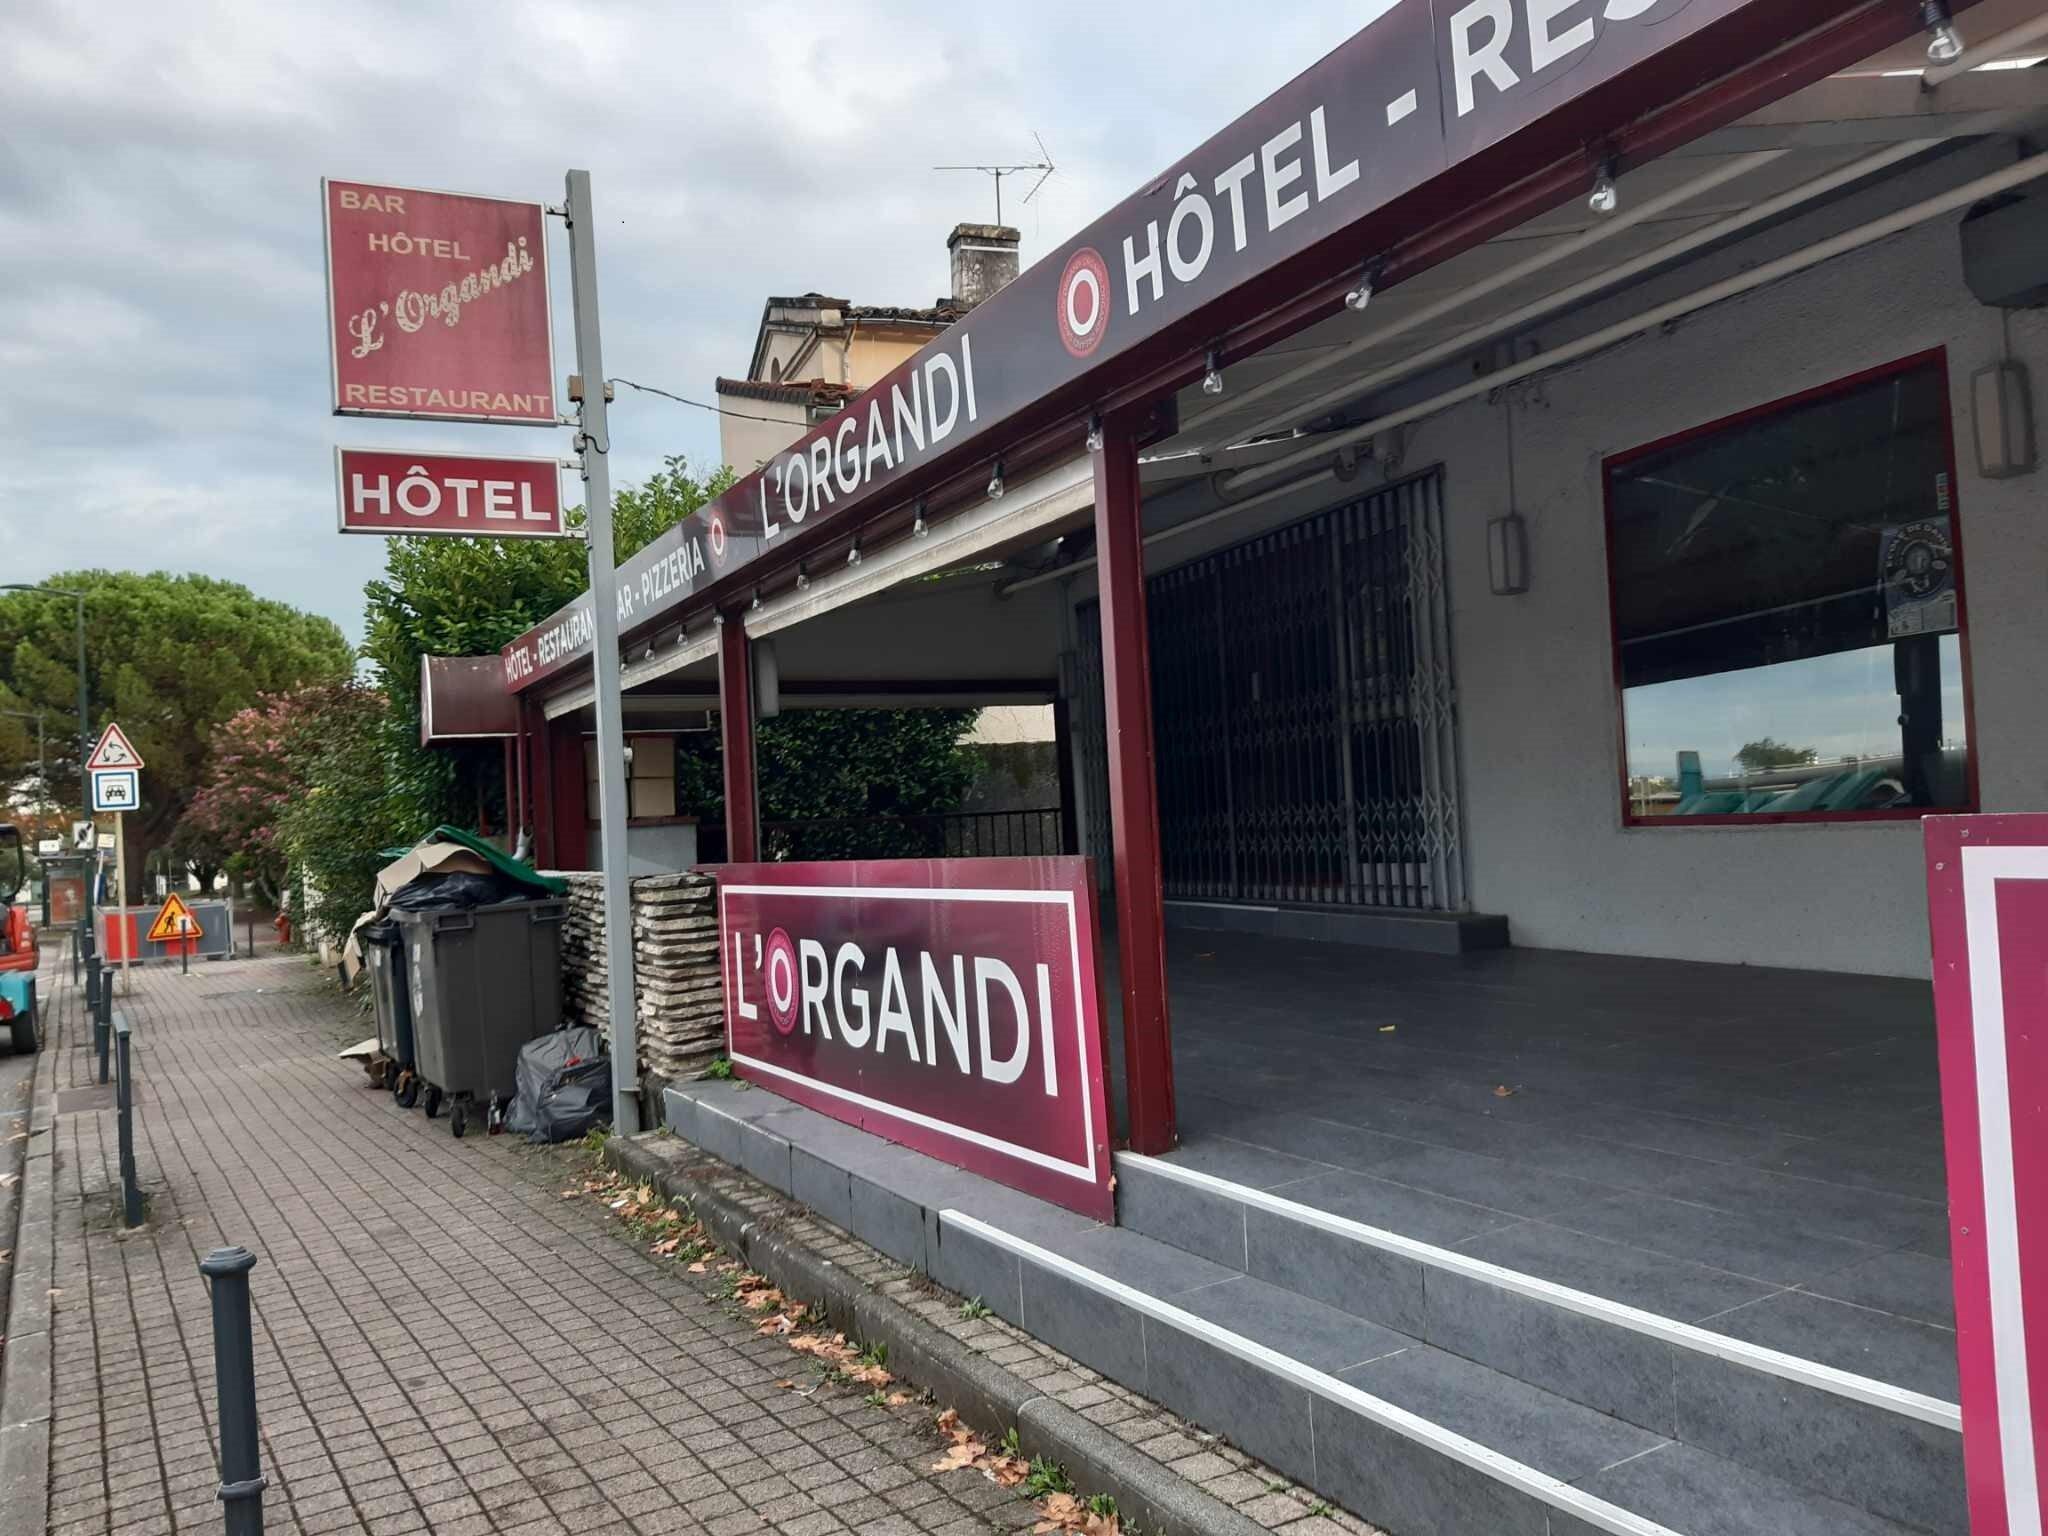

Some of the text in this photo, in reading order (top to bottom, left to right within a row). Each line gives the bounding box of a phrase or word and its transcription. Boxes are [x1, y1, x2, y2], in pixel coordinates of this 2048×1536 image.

[340, 190, 405, 214] BAR
[369, 232, 470, 261] HÔTEL
[1123, 104, 1360, 316] HÔTEL
[348, 235, 534, 359] L'Organdi
[345, 384, 550, 414] RESTAURANT
[759, 333, 978, 540] L'ORGANDI
[352, 465, 552, 521] HÔTEL
[504, 647, 533, 684] HÔTEL
[616, 584, 633, 622] AR
[641, 536, 705, 606] PIZZERIA
[735, 931, 1058, 1097] L'ORGANDI
